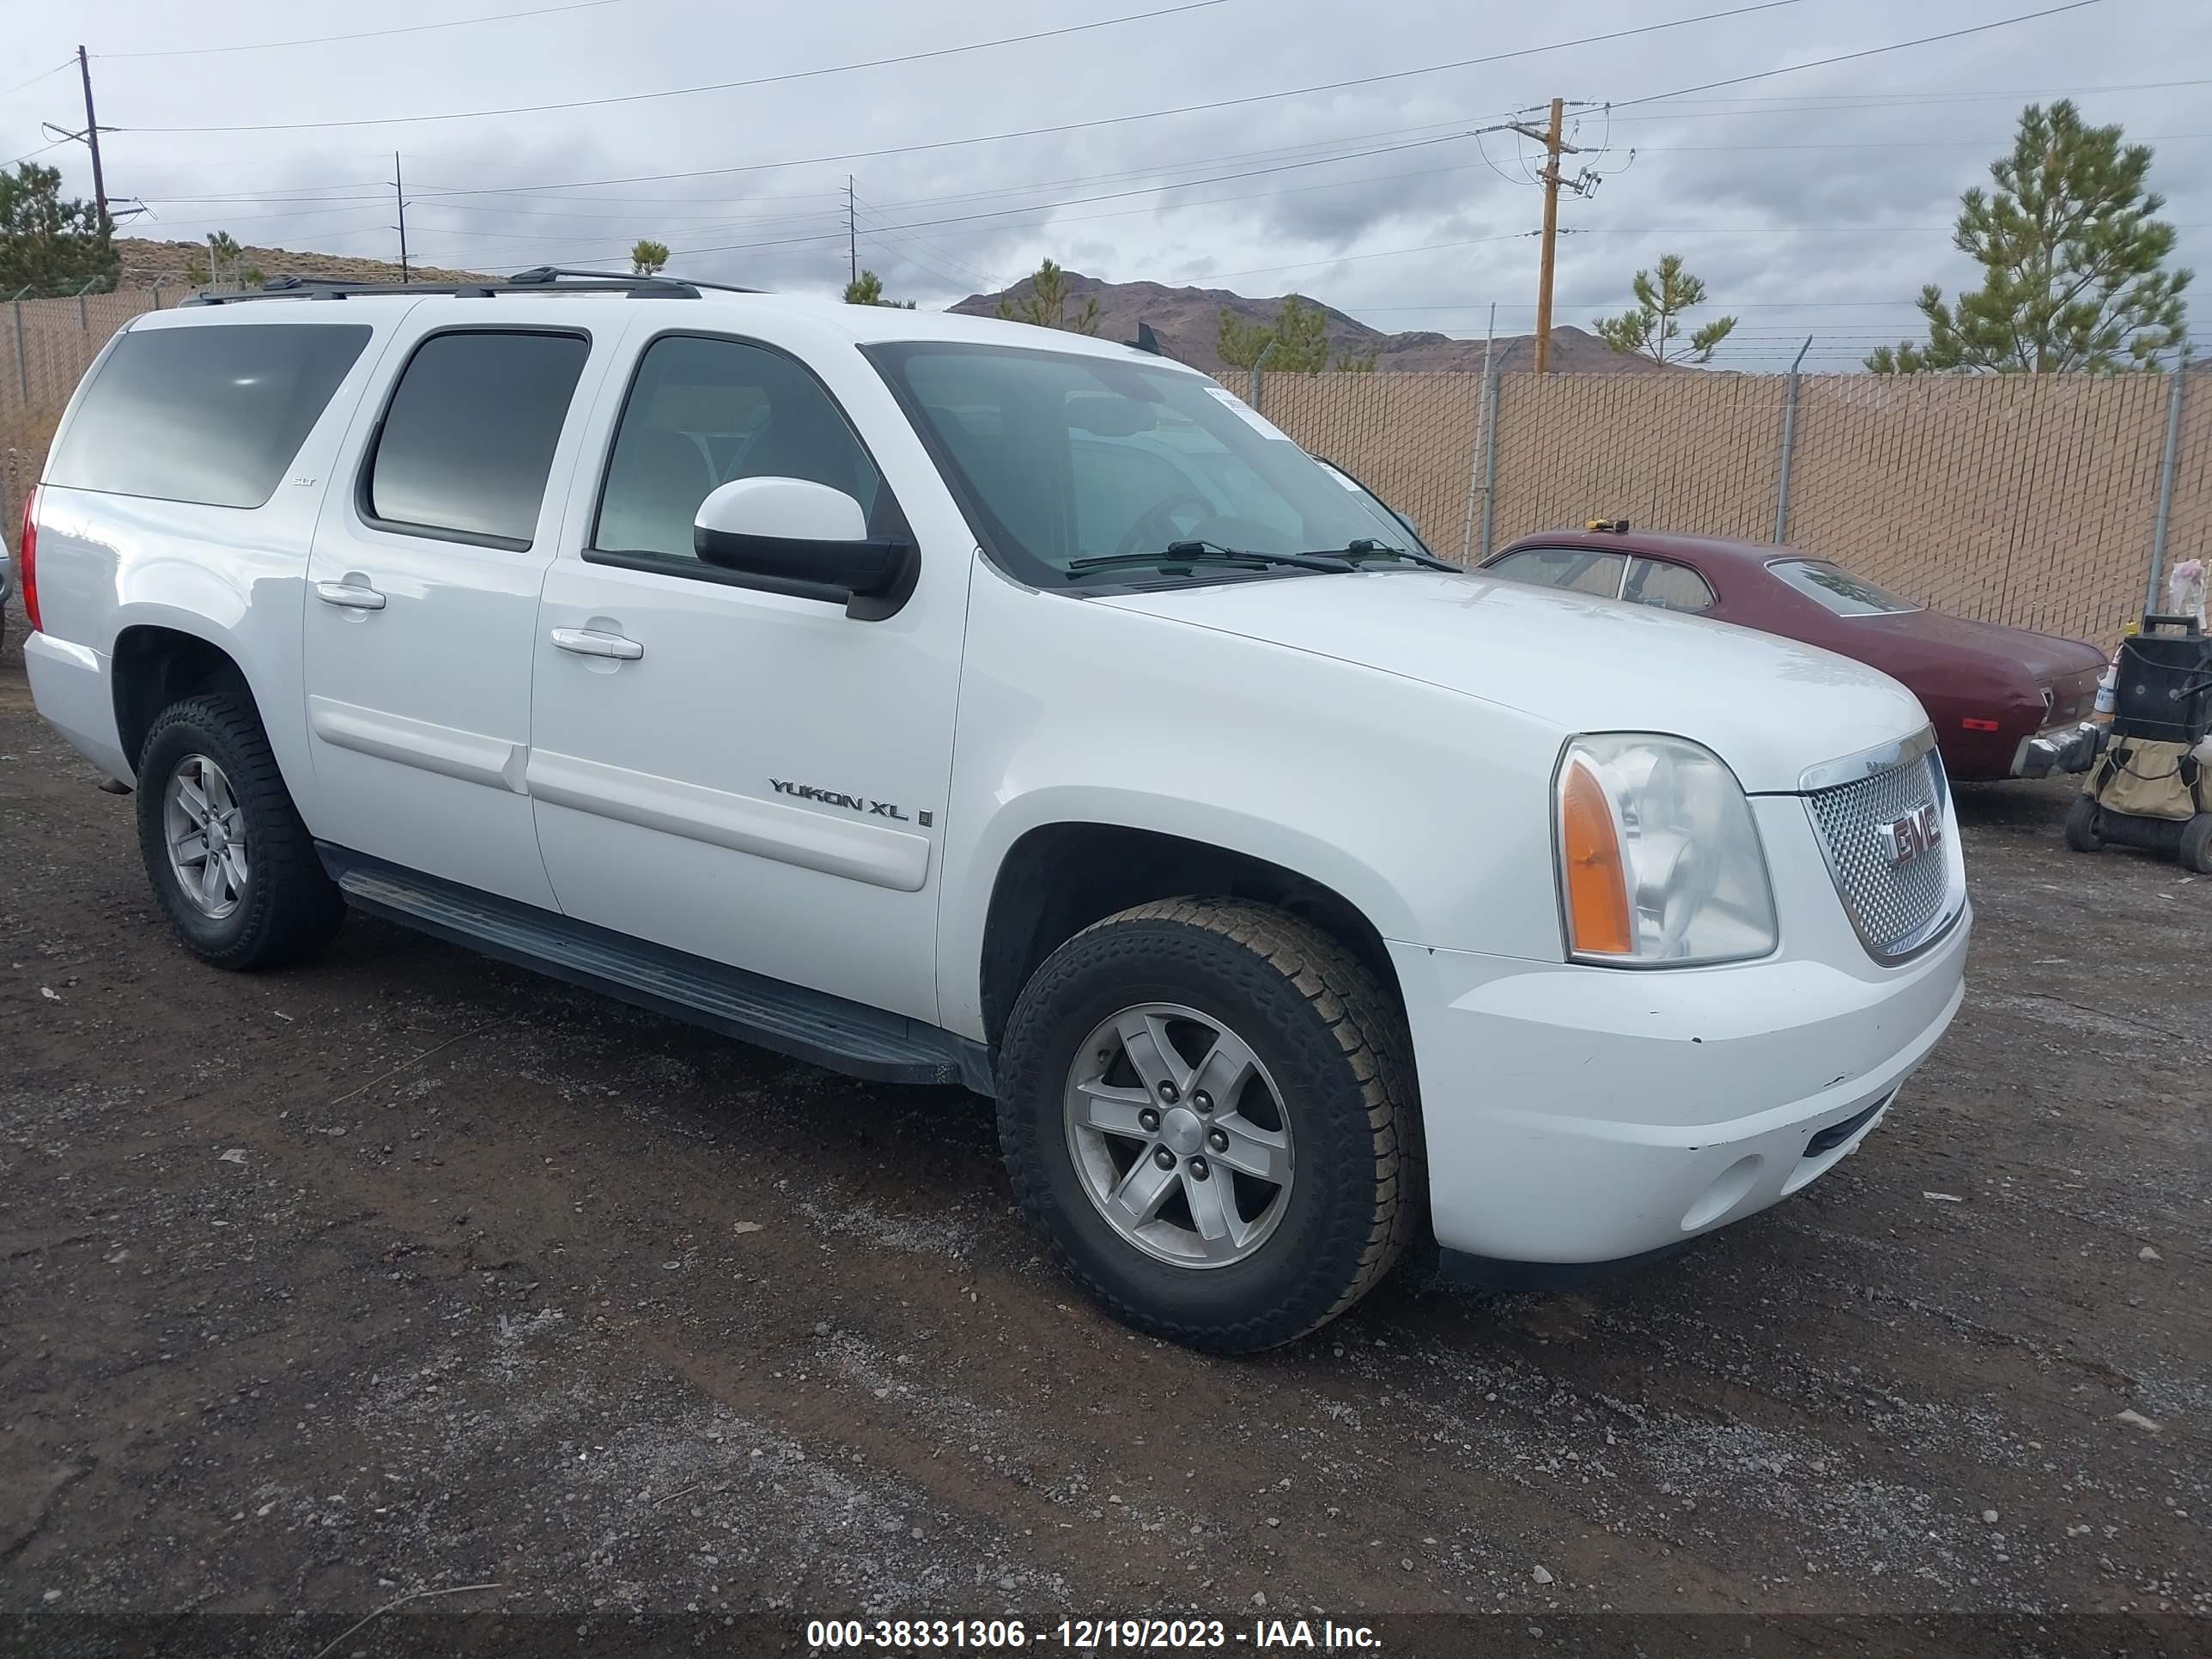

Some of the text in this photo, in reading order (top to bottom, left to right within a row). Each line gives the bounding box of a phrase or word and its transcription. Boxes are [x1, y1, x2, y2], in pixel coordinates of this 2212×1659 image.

[292, 477, 317, 487] SLT
[767, 776, 863, 811] YUKON
[868, 799, 908, 821] XL
[1885, 800, 1941, 866] GMC
